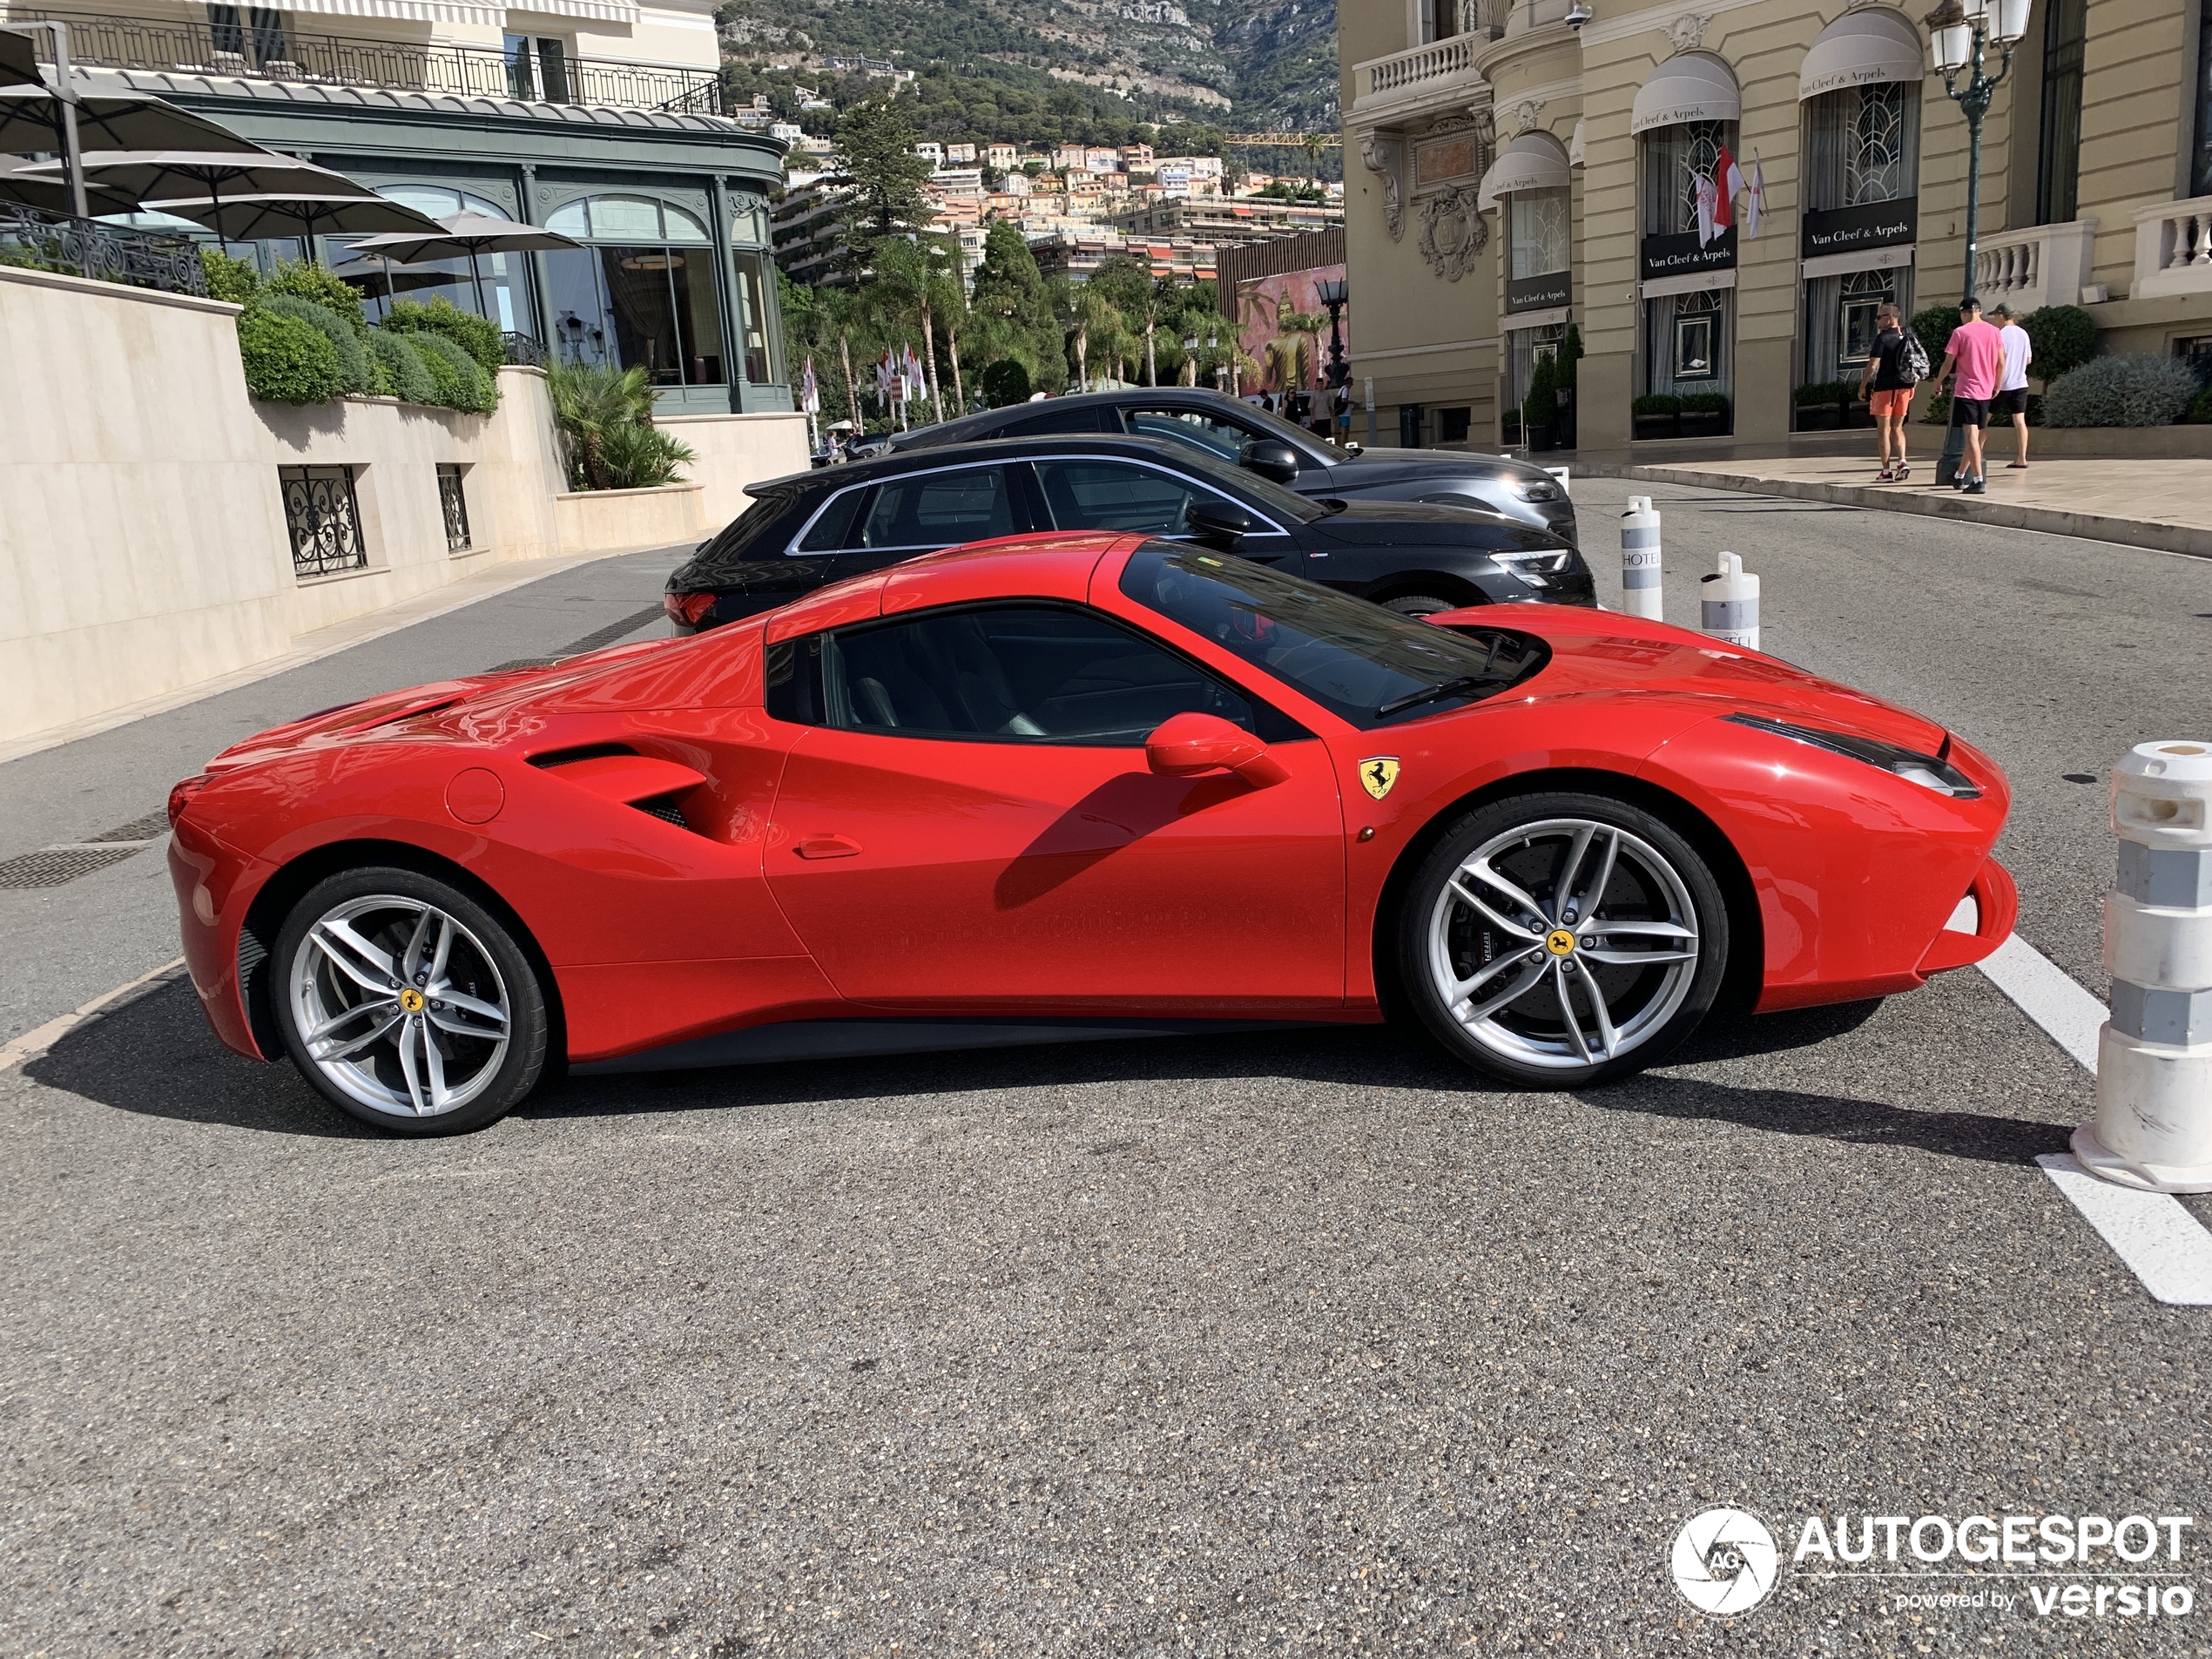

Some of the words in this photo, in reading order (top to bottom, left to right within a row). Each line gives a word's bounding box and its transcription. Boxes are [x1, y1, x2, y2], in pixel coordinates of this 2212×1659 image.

[1812, 75, 1837, 90] Cleef
[1838, 75, 1846, 84] &
[1850, 67, 1885, 83] Arpels
[1640, 112, 1661, 126] Cleef
[1673, 106, 1704, 120] Arpels
[1514, 177, 1538, 187] Arpels
[1812, 233, 1831, 245] Van
[1833, 228, 1862, 242] Cleef
[1864, 229, 1871, 238] &
[1873, 221, 1908, 238] Arpels
[1649, 258, 1666, 267] Van
[1667, 253, 1691, 266] Cleef
[1692, 253, 1700, 262] &
[1701, 247, 1730, 262] Arpels
[1512, 296, 1524, 305] Van
[1524, 293, 1541, 303] Cleef
[1547, 289, 1566, 301] Arpels
[1622, 552, 1661, 566] HOTEL
